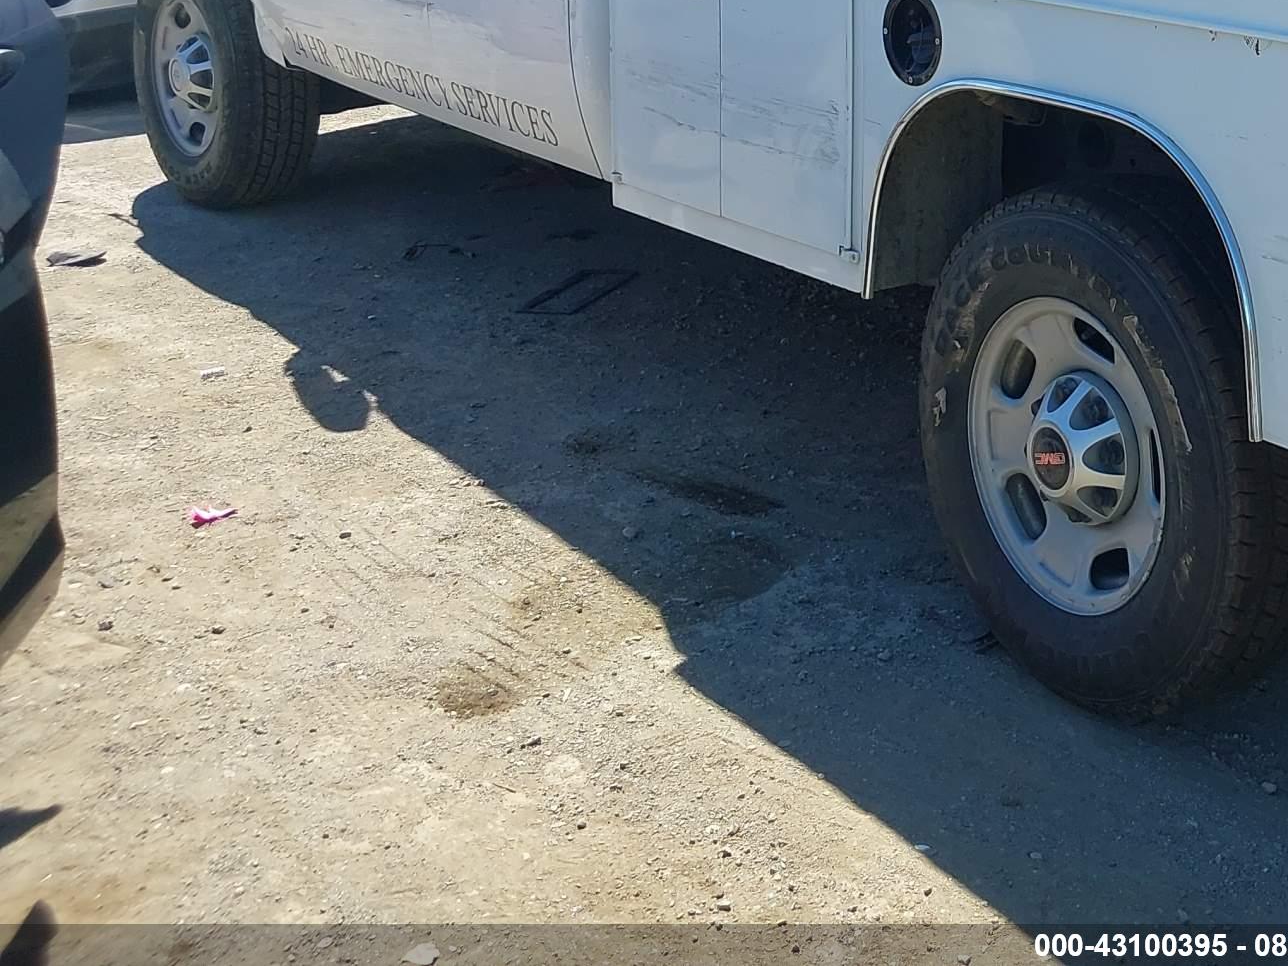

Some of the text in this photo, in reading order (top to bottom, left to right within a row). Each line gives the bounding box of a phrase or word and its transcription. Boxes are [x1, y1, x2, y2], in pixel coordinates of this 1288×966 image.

[285, 27, 307, 59] 24
[334, 44, 453, 111] EMERGENCY
[450, 82, 559, 146] SERVICES
